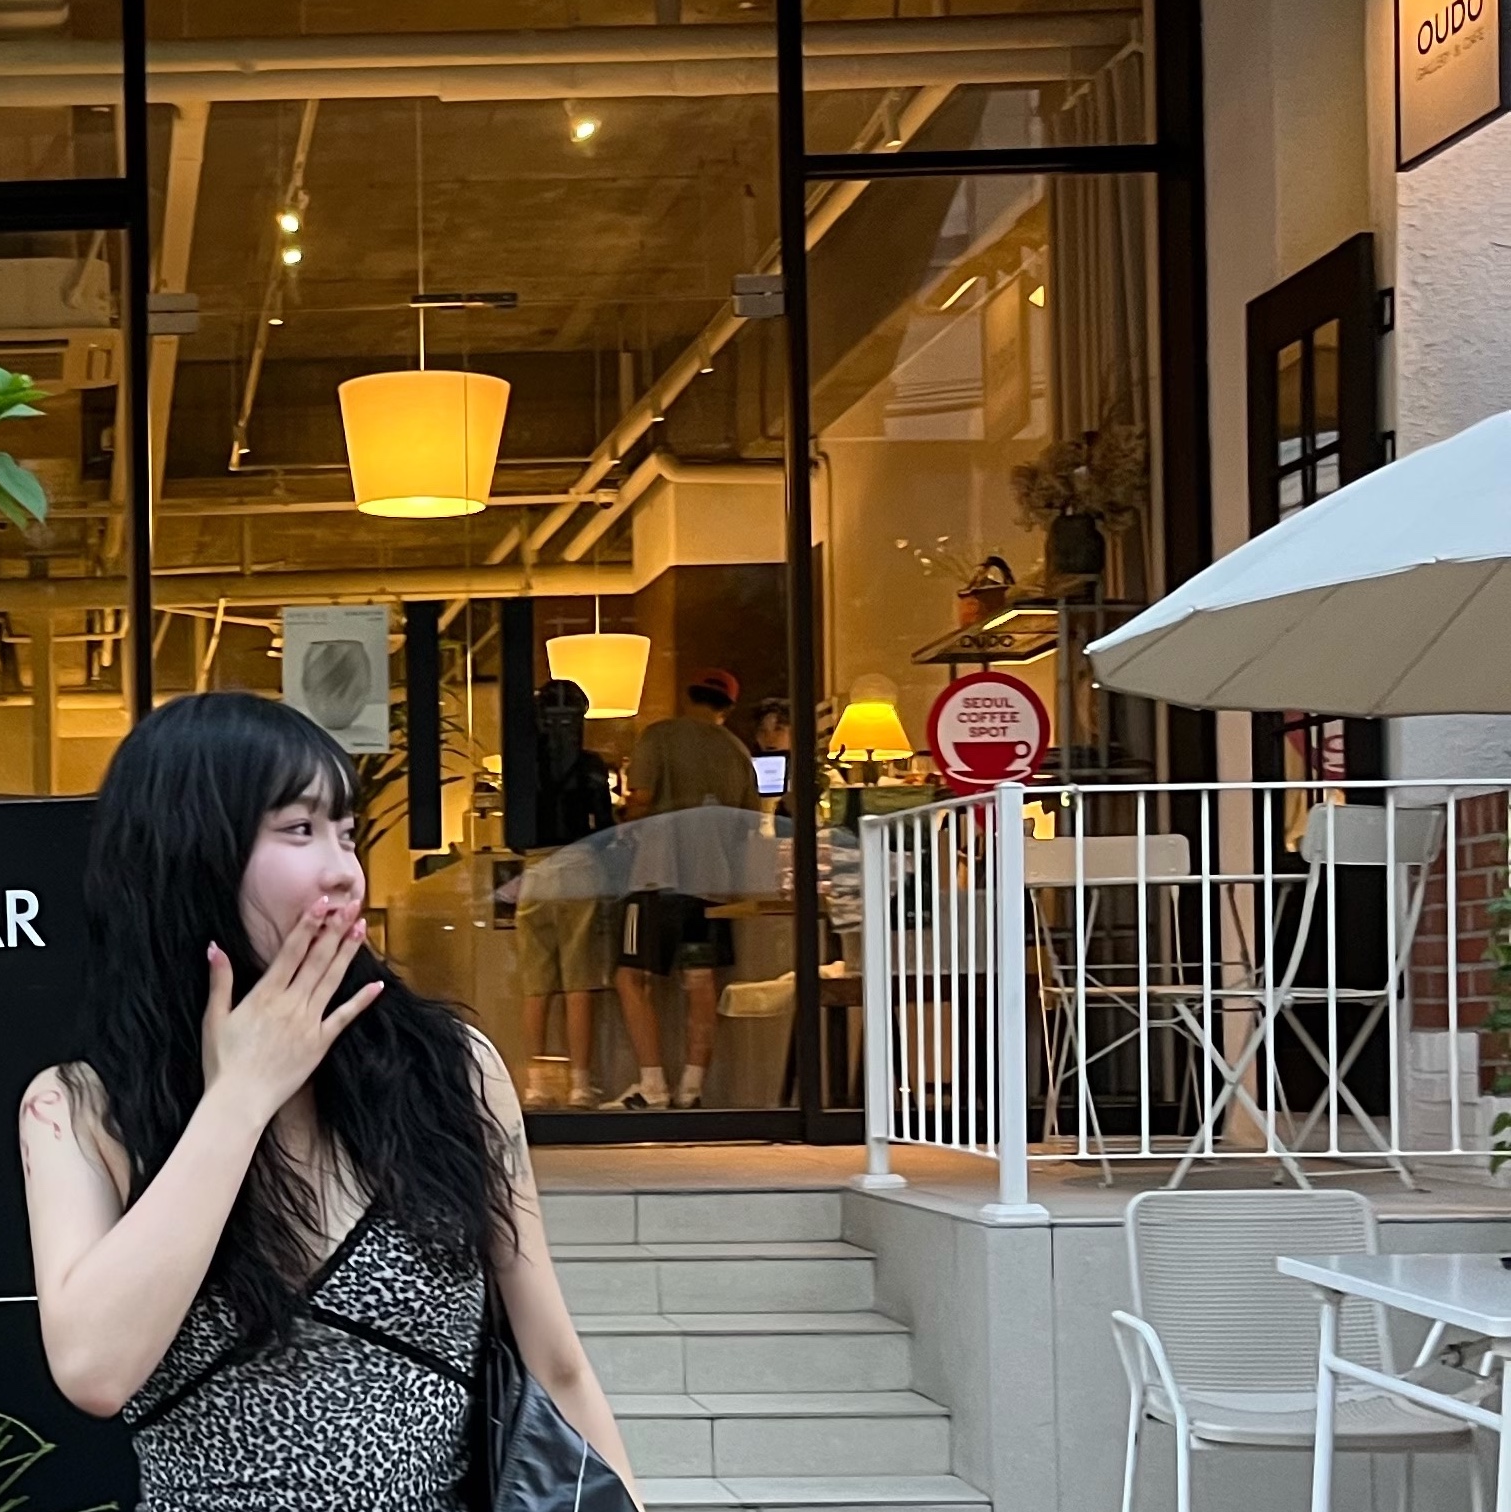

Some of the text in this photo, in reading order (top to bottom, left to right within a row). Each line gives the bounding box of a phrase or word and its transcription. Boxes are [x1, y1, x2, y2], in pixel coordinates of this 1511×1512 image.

[962, 697, 1014, 709] SEOUL
[957, 712, 1020, 724] COFFEE
[968, 726, 1008, 738] SPOT
